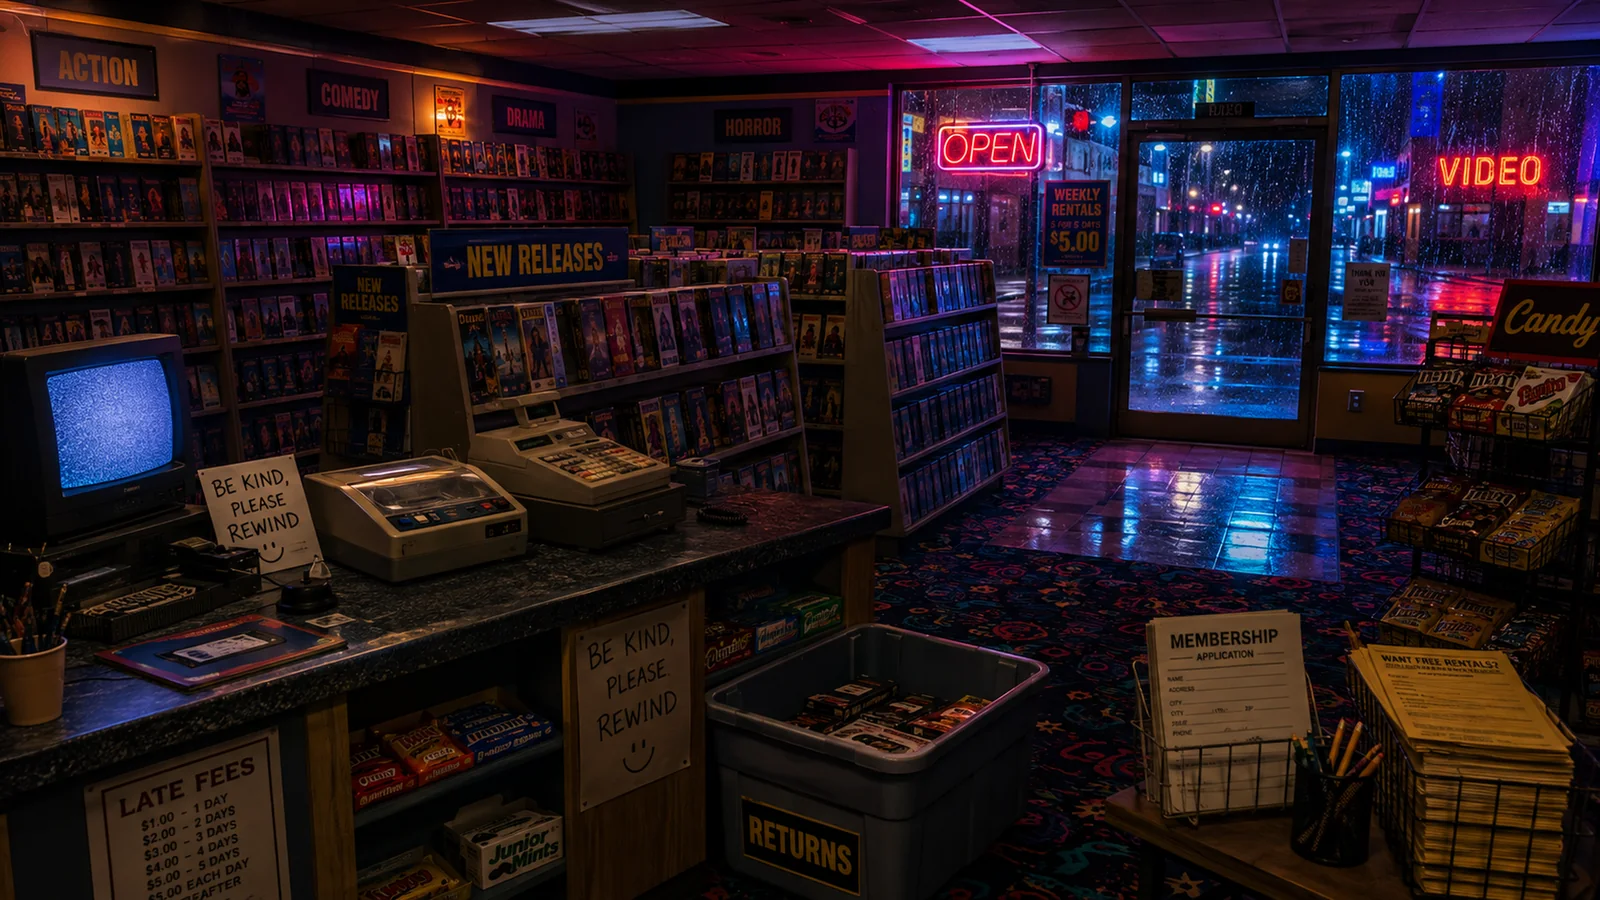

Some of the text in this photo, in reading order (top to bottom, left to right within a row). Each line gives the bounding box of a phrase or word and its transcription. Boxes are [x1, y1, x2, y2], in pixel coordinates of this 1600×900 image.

[58, 50, 139, 87] ACTION
[320, 82, 380, 112] COMEDY
[507, 105, 545, 130] DRAMA
[725, 116, 782, 137] HORROR
[943, 132, 1037, 165] OPEN
[1439, 155, 1542, 186] VIDEO
[1051, 203, 1102, 216] RENTALS
[1053, 187, 1101, 201] WEEKLY
[1050, 230, 1100, 253] $5.00
[466, 241, 604, 279] NEW RELEASES
[356, 276, 382, 292] NEW
[340, 292, 399, 313] RELEASES
[1504, 298, 1600, 349] Candy
[211, 469, 289, 498] BE KIND,
[230, 492, 287, 517] PLEASE
[227, 512, 299, 543] REWIND
[587, 638, 614, 670] BE
[624, 622, 675, 656] KIND,
[1170, 628, 1278, 650] MEMBERSHIP
[1196, 650, 1254, 661] APPLICATION
[1380, 654, 1412, 664] WANT
[1415, 656, 1442, 666] FREE
[1444, 658, 1499, 669] RENTALS?
[597, 690, 678, 742] REWIND
[119, 757, 255, 818] LATE FEES
[141, 811, 175, 832] $1.00
[194, 803, 200, 814] 1
[204, 792, 229, 810] DAY
[142, 826, 176, 847] $2.00
[194, 817, 202, 828] 2
[205, 805, 236, 824] DAYS
[144, 841, 178, 861] $3.00
[196, 831, 203, 842] 3
[206, 820, 237, 839] DAYS
[146, 855, 179, 876] $4.00
[197, 846, 204, 856] 4
[208, 833, 239, 852] DAYS
[489, 829, 549, 865] Junior
[512, 841, 559, 869] Mints
[748, 813, 854, 877] RETURNS
[147, 870, 181, 891] $5.00
[198, 860, 206, 871] 5
[209, 847, 240, 867] DAYS
[186, 869, 221, 891] EACH
[225, 857, 249, 875] DAY
